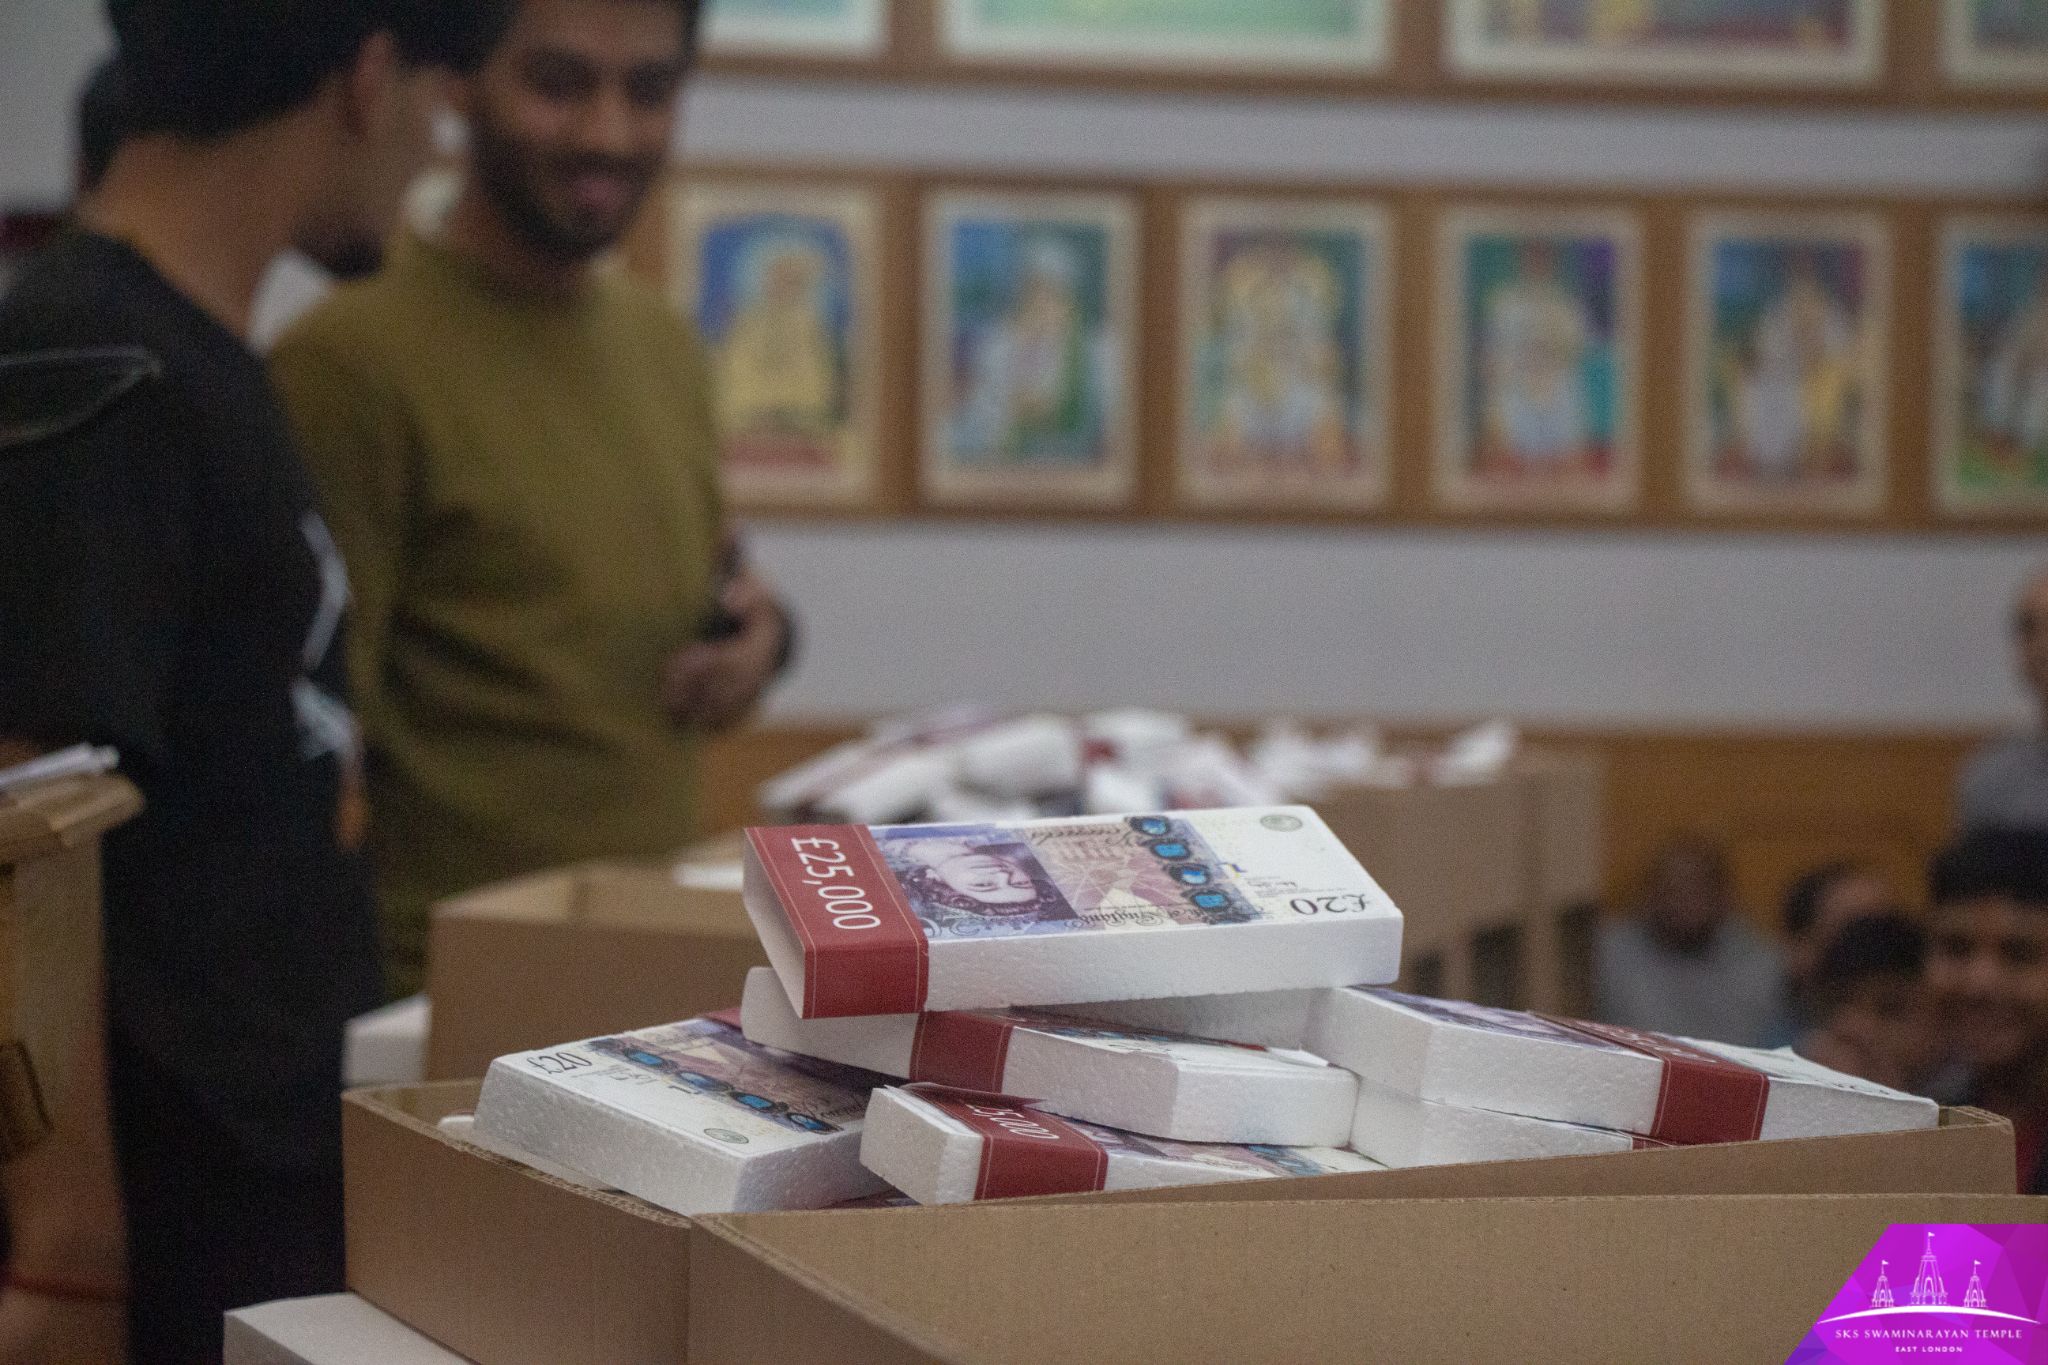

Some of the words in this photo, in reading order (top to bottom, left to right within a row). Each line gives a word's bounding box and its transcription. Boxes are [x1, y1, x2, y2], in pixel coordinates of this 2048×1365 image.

[790, 837, 881, 930] £25,000
[1289, 893, 1371, 916] £20
[527, 1050, 594, 1075] £20
